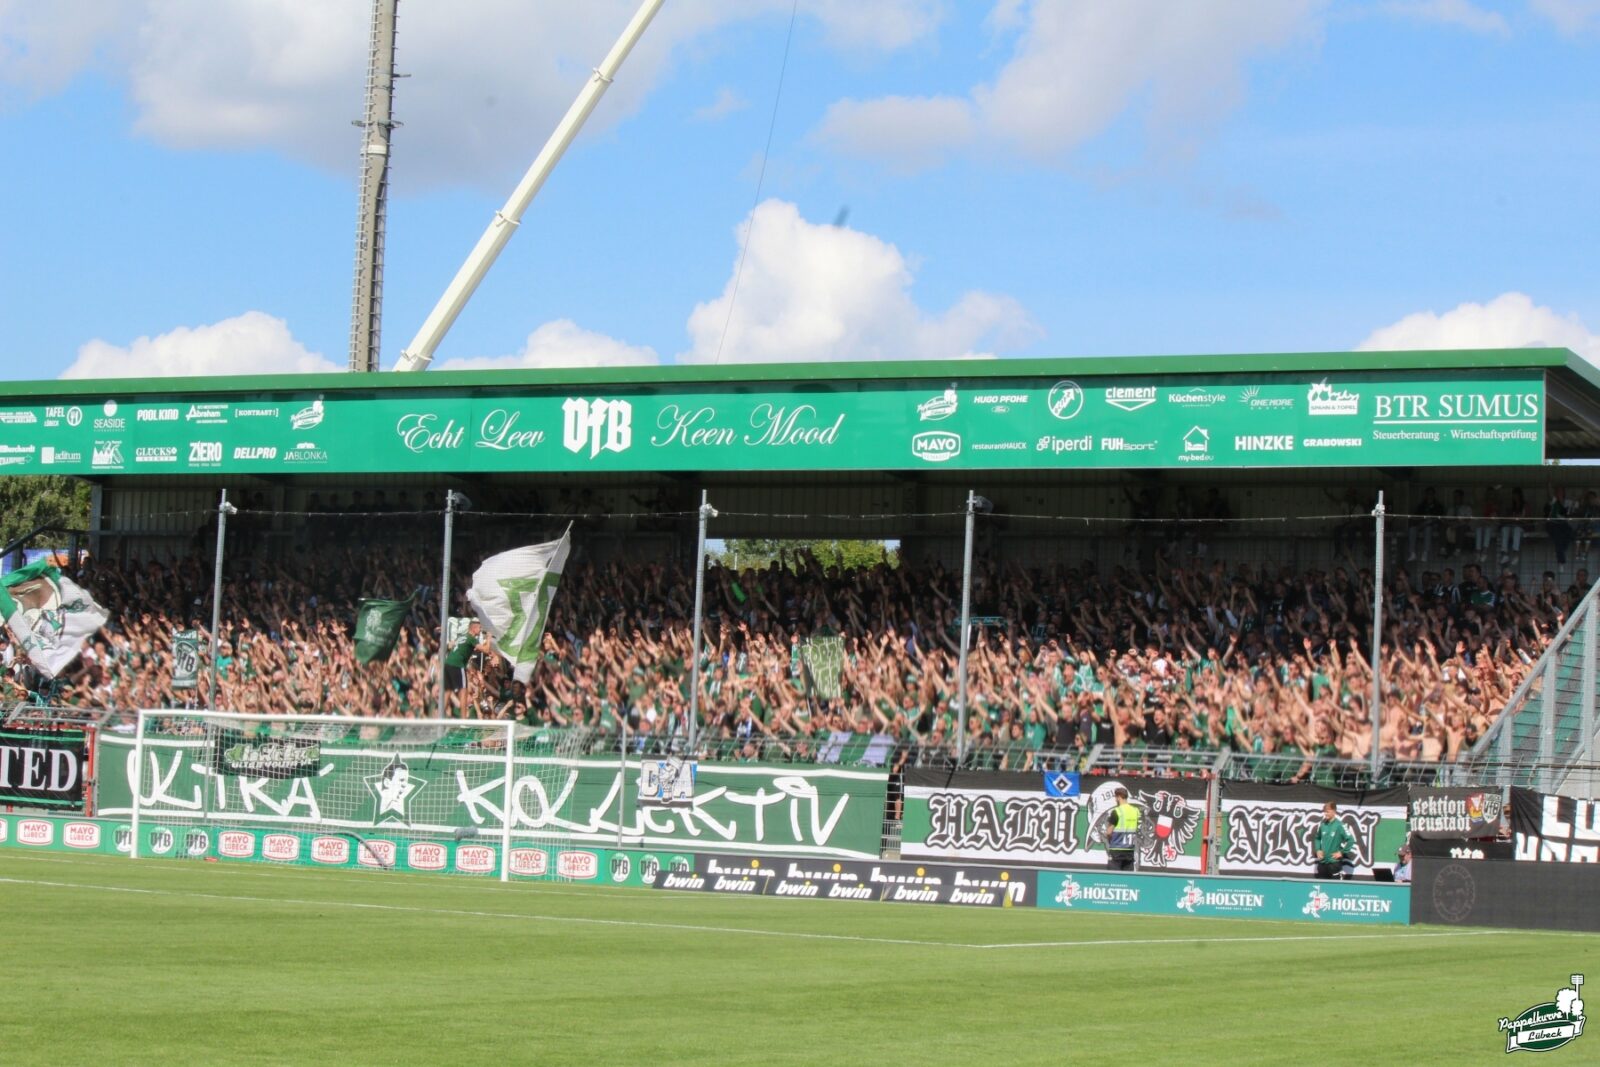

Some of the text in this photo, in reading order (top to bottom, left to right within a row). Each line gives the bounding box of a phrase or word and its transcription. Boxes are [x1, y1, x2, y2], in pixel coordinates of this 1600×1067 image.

[1105, 386, 1157, 399] clement
[974, 395, 998, 403] HUGO
[1374, 394, 1538, 418] BTR SUMUS
[45, 407, 65, 417] TAFEL
[93, 418, 125, 429] SEASIDE
[397, 397, 845, 459] Echt Leev VfB Keen Mood
[1372, 429, 1538, 441] Steuerberatung Wirtschaftsprüfung
[917, 438, 956, 451] MAYO
[1052, 435, 1092, 455] iperdi
[1235, 435, 1294, 451] HINZKE
[1303, 438, 1362, 448] GRABOWSKI
[234, 447, 277, 459] DELLPRO
[284, 450, 328, 461] JABLONKA
[24, 824, 47, 832] MAYO
[70, 827, 94, 835] MAYO
[225, 836, 249, 844] MAYO
[269, 838, 294, 846] MAYO
[319, 842, 343, 850] MAYO
[415, 847, 440, 856] MAYO
[463, 850, 488, 858] MAYO
[515, 853, 541, 861] MAYO
[564, 855, 590, 864] MAYO
[663, 873, 994, 904] bwin bwin bwin bwin bwin bwin
[1083, 886, 1139, 901] HOLSTEN
[1206, 892, 1263, 907] HOLSTEN
[1332, 898, 1391, 912] HOLSTEN
